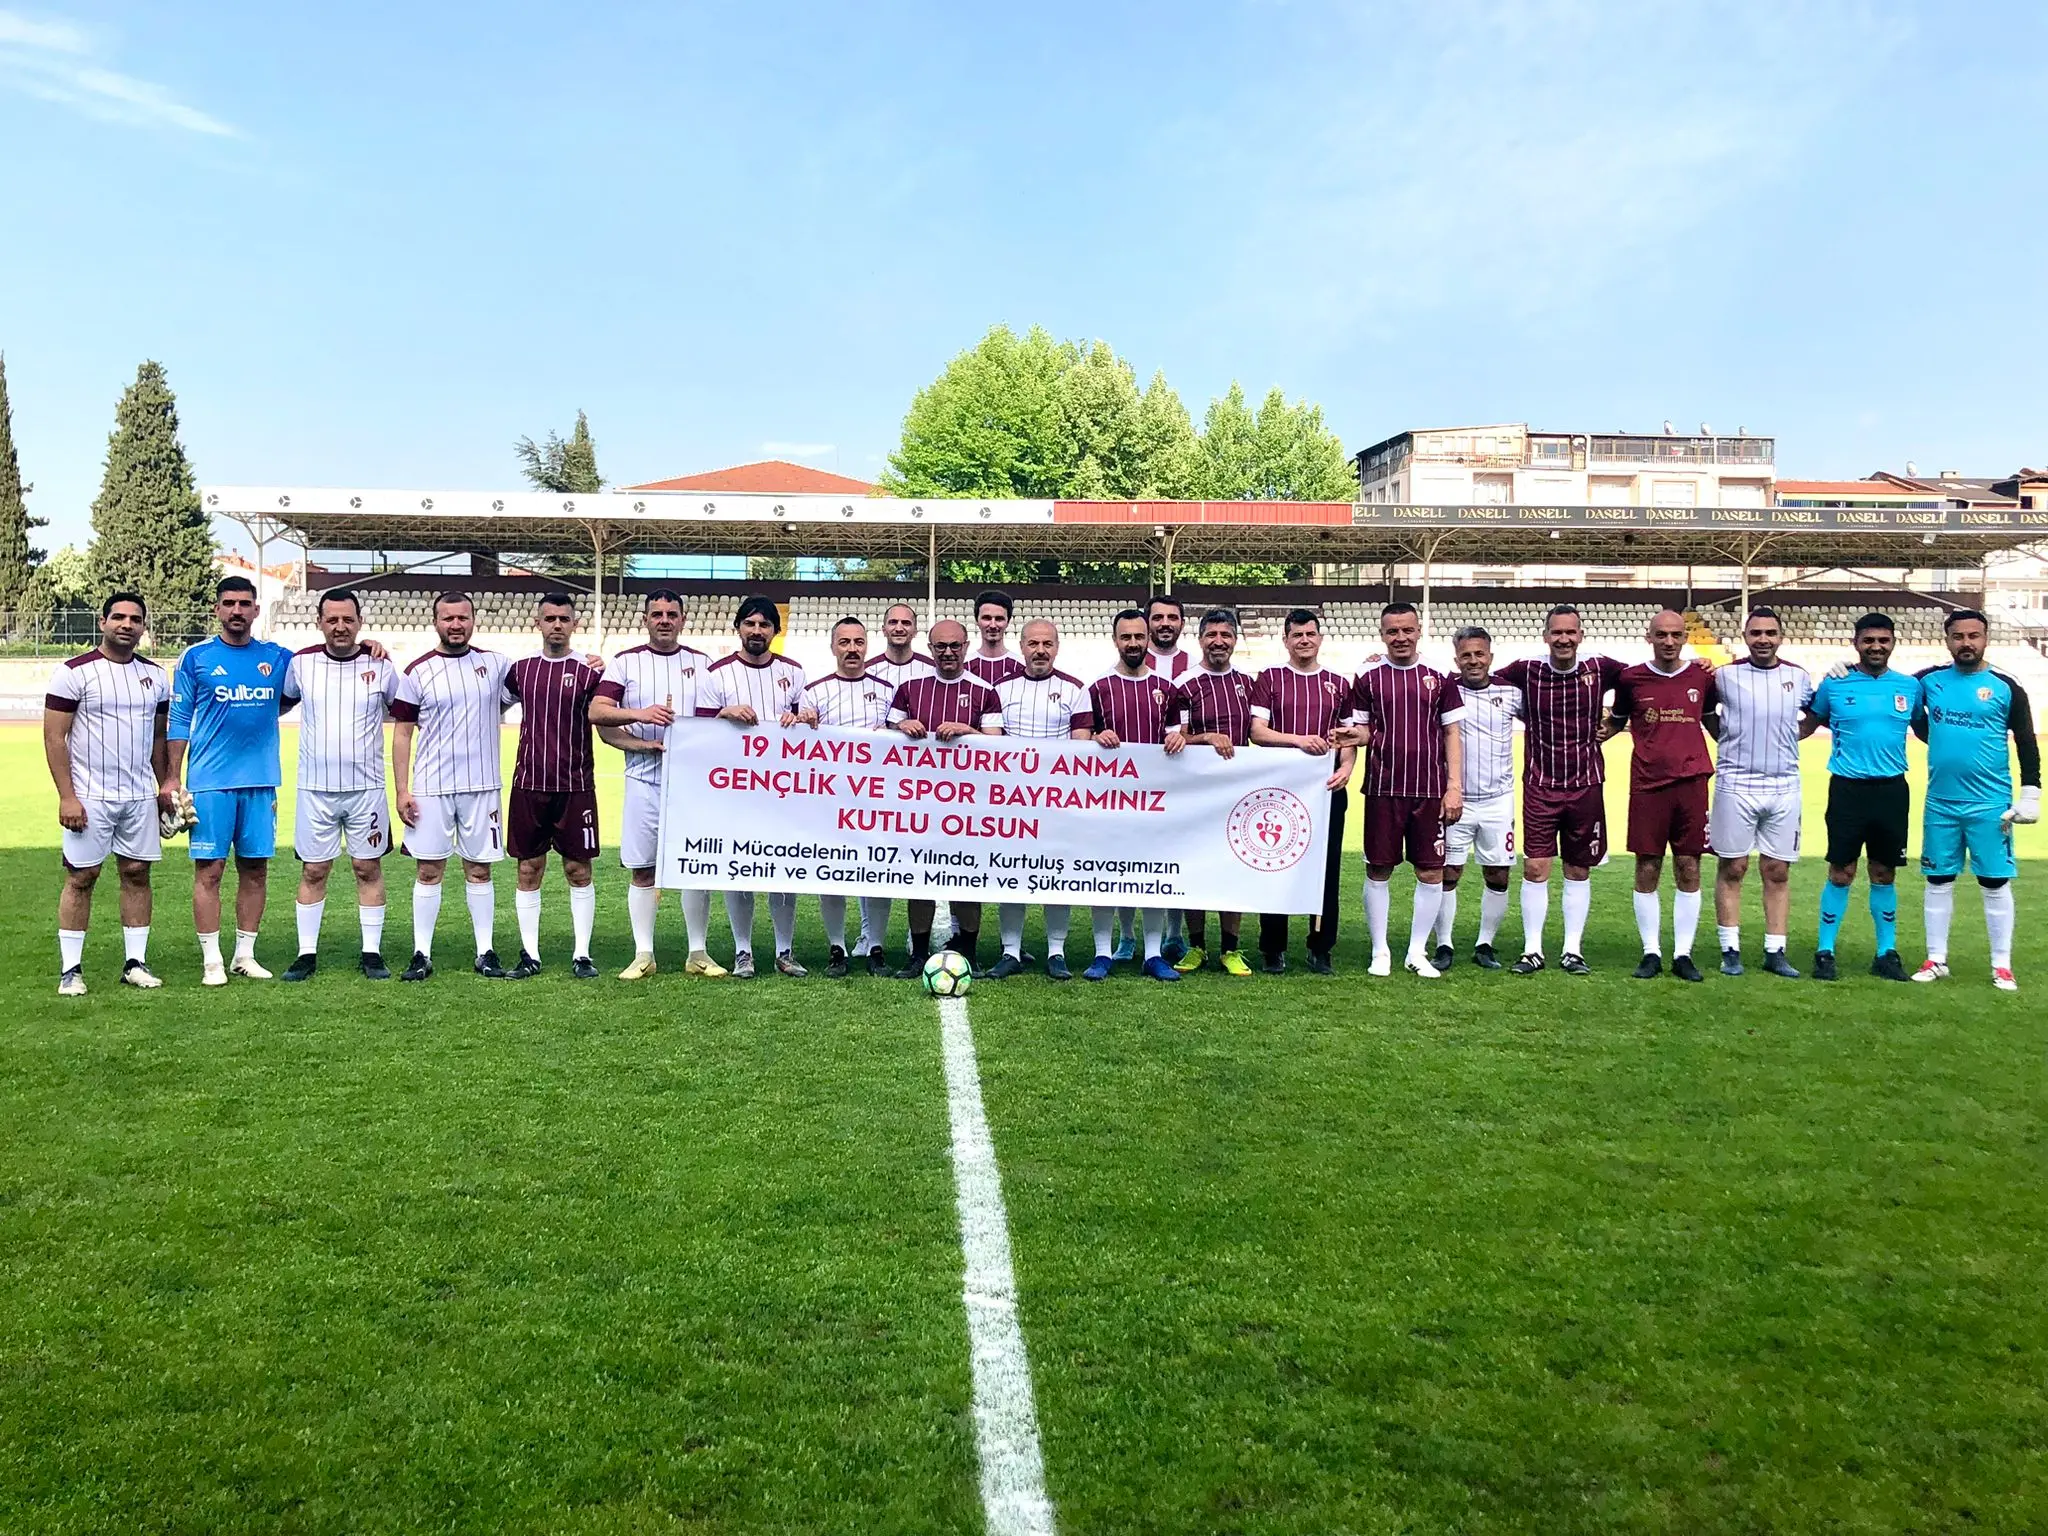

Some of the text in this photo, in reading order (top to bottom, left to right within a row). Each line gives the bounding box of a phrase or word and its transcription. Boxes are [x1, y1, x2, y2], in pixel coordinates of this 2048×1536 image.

[1393, 507, 1446, 518] DASELL
[1458, 508, 1510, 519] DASELL
[1519, 508, 1571, 519] DASELL
[1586, 509, 1637, 520] DASELL
[1646, 509, 1698, 520] DASELL
[1711, 510, 1763, 521] DASELL
[1771, 511, 1824, 522] DASELL
[1836, 512, 1888, 523] DASELL
[1896, 513, 1947, 524] DASELL
[1961, 513, 2013, 524] DASELL
[215, 684, 275, 702] Sultan
[742, 735, 1139, 779] 19 MAYIS ATATÜRK'Ü ANMA
[709, 767, 1166, 811] GENÇLİK VE SPOR BAYRAMINIZ
[369, 811, 379, 830] 2
[838, 808, 1038, 839] KUTLU OLSUN
[582, 827, 596, 850] 11
[1437, 821, 1445, 839] 3
[1592, 821, 1601, 839] 4
[1504, 831, 1515, 852] 8
[686, 838, 1179, 876] Milli Mücadelenin 107. Yılında, Kurtuluş savaşımızın
[678, 858, 1184, 895] Tüm Şehit ve Gazilerine Minnet ve Şükranlarımızla...
